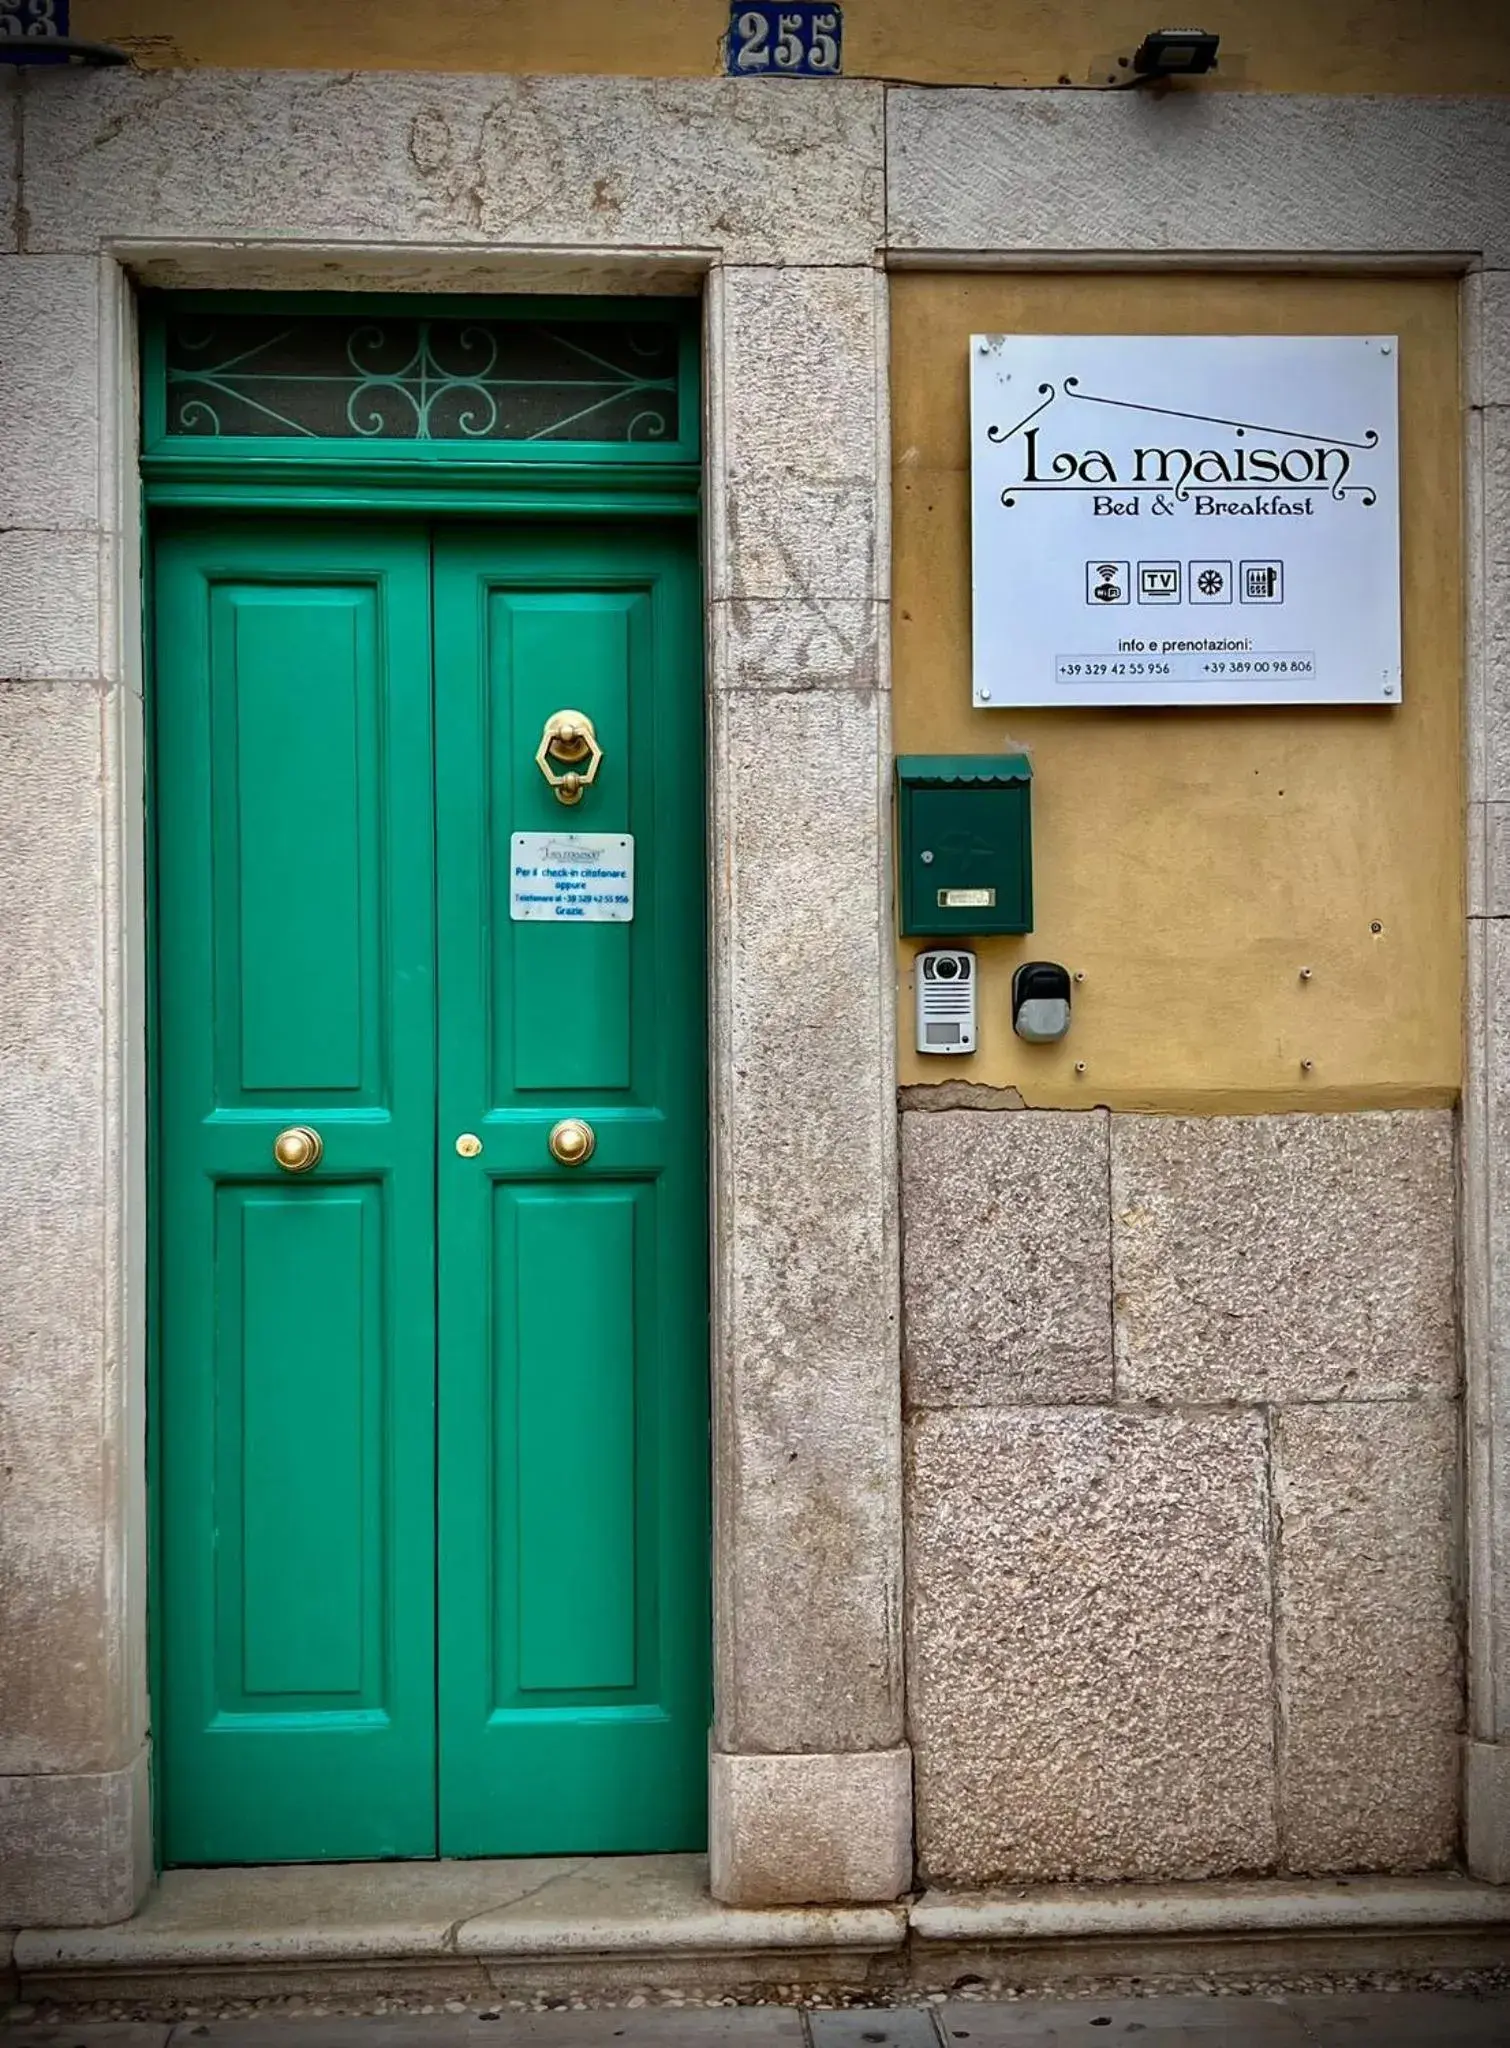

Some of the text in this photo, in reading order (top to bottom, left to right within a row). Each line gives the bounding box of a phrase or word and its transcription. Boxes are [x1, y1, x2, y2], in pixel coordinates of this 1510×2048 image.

[738, 11, 837, 68] 255
[1023, 427, 1350, 501] La maison
[1093, 494, 1314, 516] Bed & Breakfast
[1147, 574, 1171, 588] TV
[1118, 637, 1253, 654] info e prenotazioni:
[1059, 663, 1170, 676] +39 329 42 55 956
[1202, 660, 1313, 673] +39 389 00 98 806
[515, 867, 531, 877] Per
